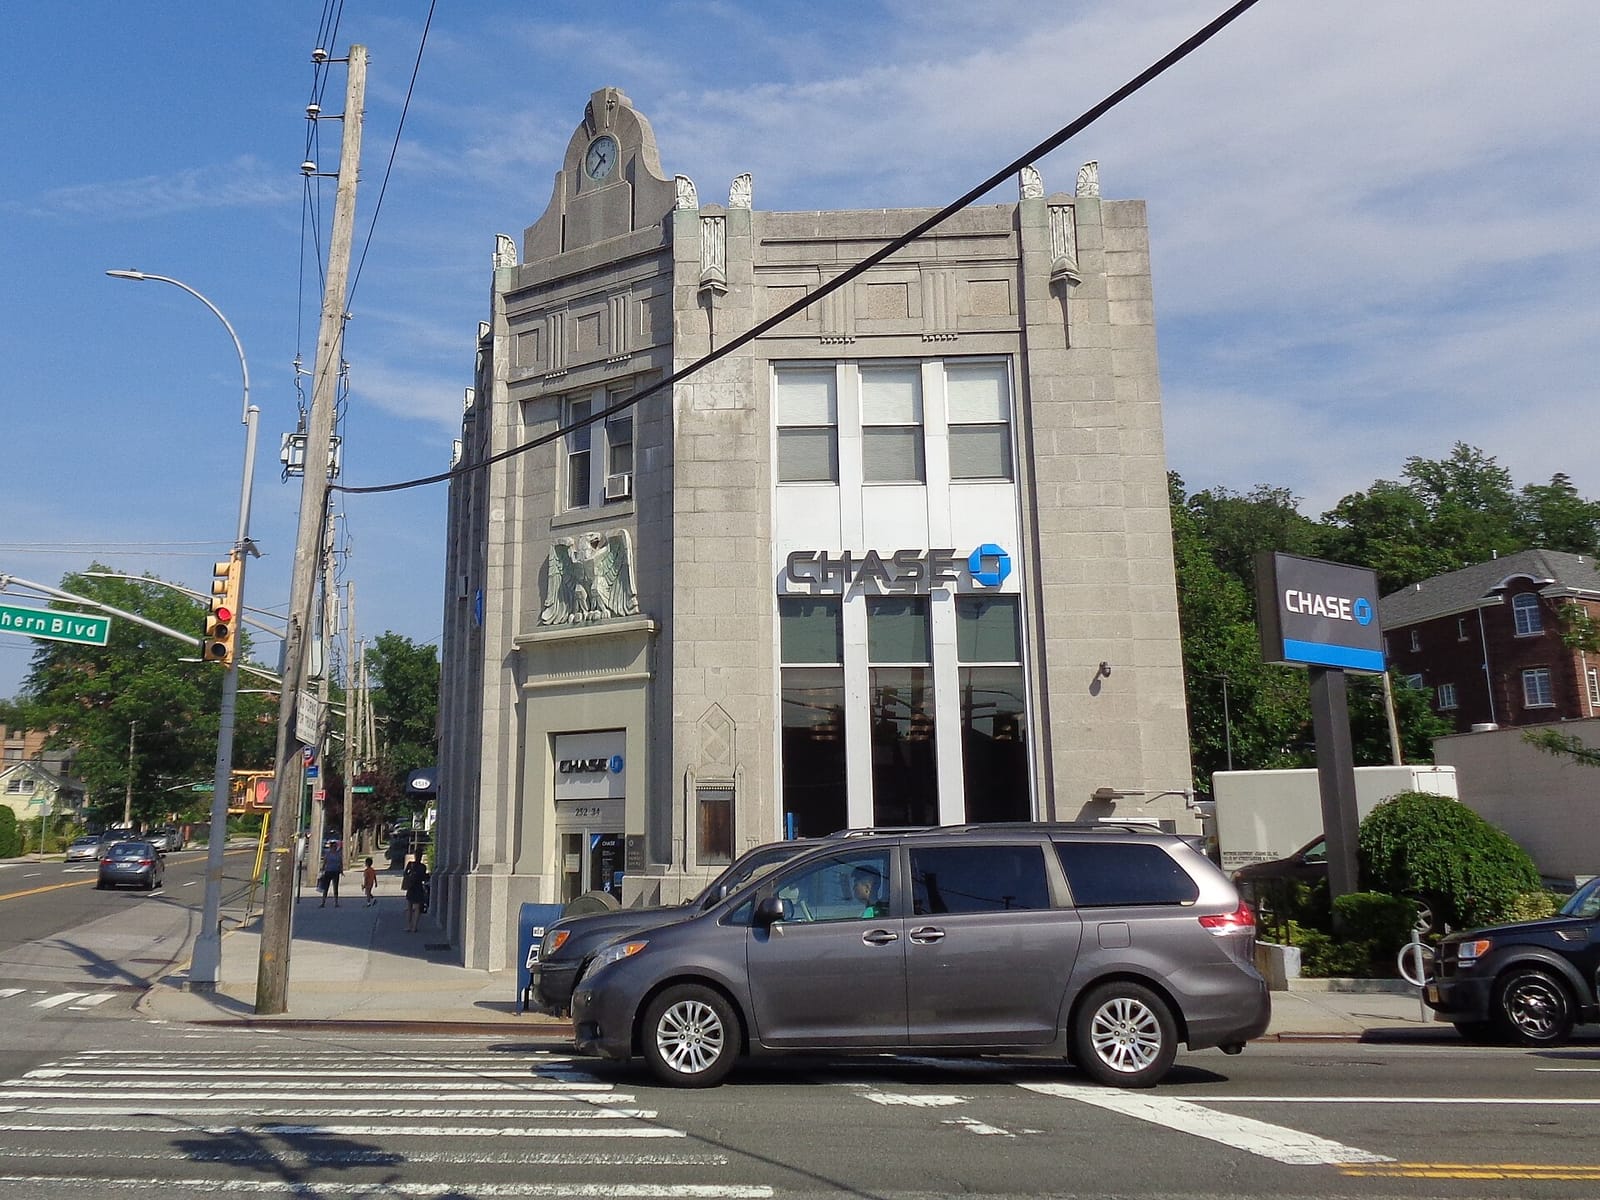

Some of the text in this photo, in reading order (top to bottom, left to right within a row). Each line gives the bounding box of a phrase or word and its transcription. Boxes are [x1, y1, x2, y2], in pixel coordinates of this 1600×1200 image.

[786, 548, 959, 584] CHASE
[1285, 589, 1353, 621] CHASE
[51, 618, 97, 638] Blvd
[560, 759, 607, 773] CHASE
